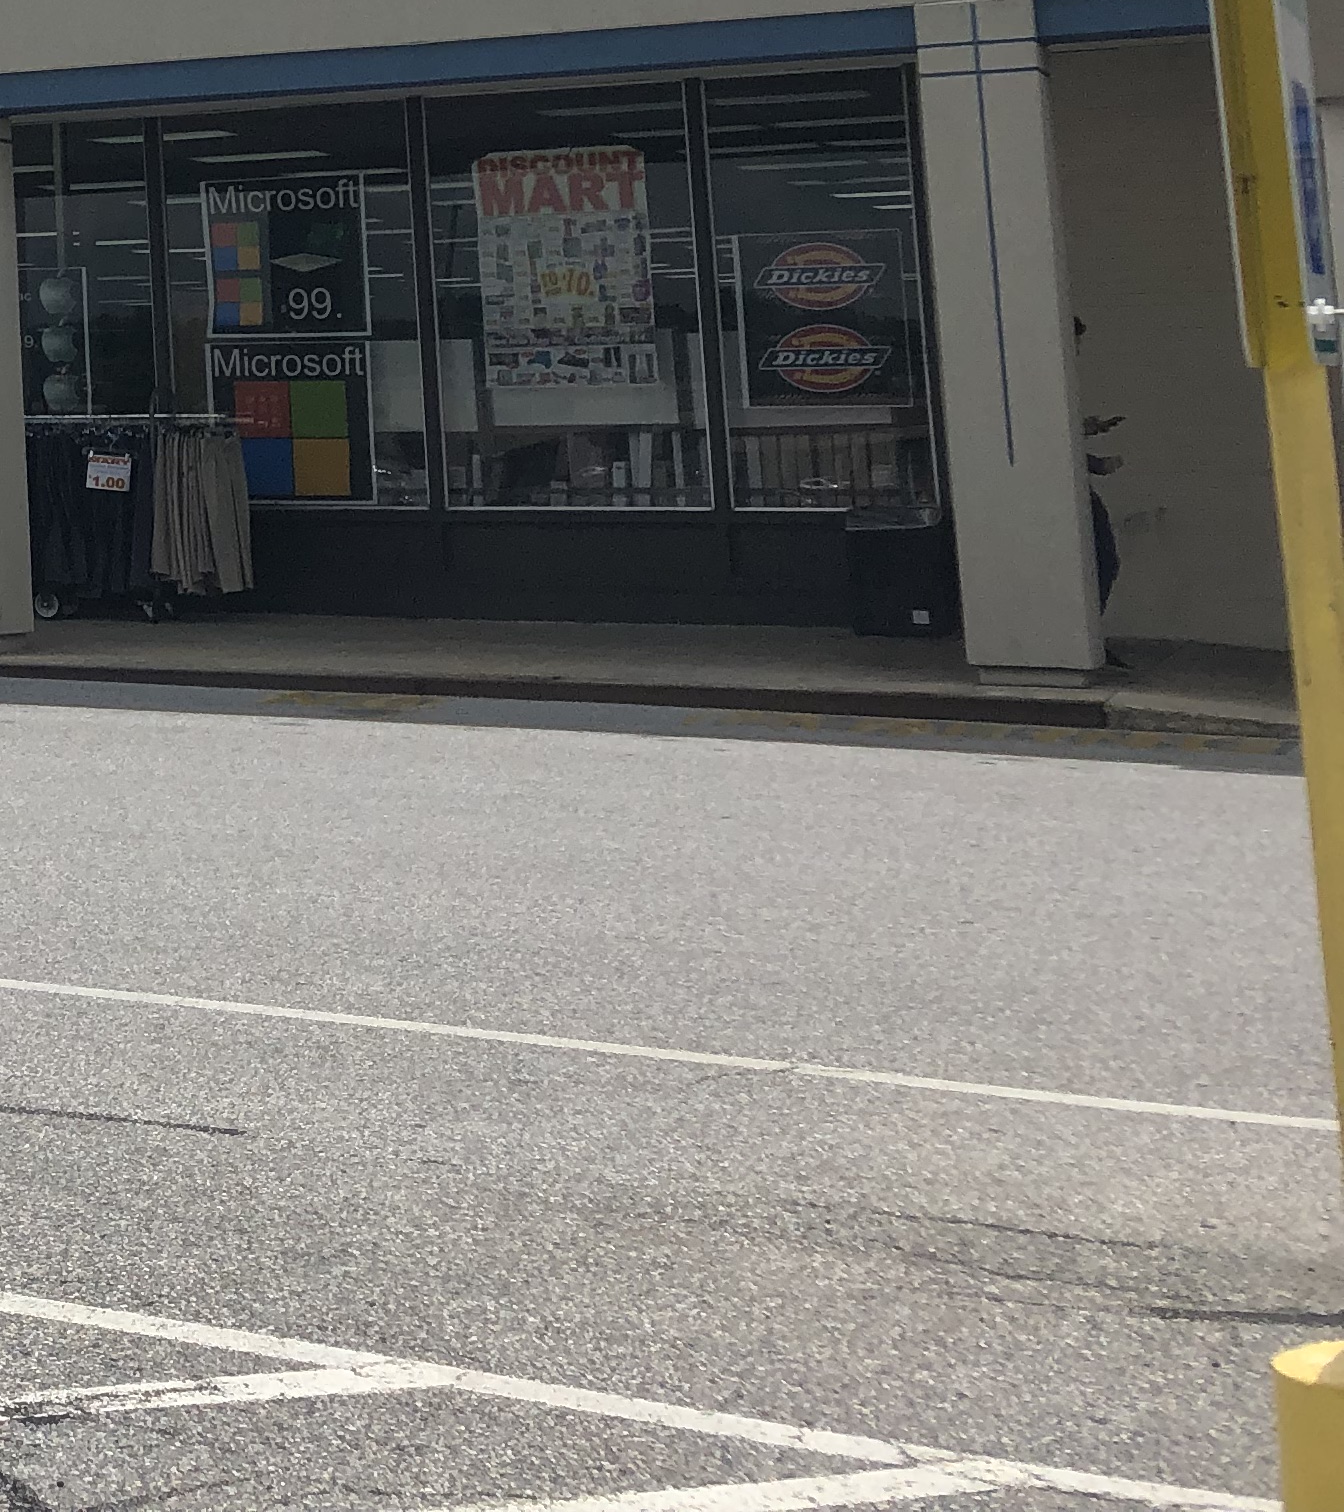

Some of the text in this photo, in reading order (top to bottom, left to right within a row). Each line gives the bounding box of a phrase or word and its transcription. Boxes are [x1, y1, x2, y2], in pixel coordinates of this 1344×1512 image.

[477, 150, 643, 174] DISCOUNT
[208, 179, 360, 214] Microsoft
[478, 170, 645, 217] MART
[767, 269, 870, 285] Dickies
[213, 346, 365, 378] Microsoft
[772, 350, 878, 366] Dickies
